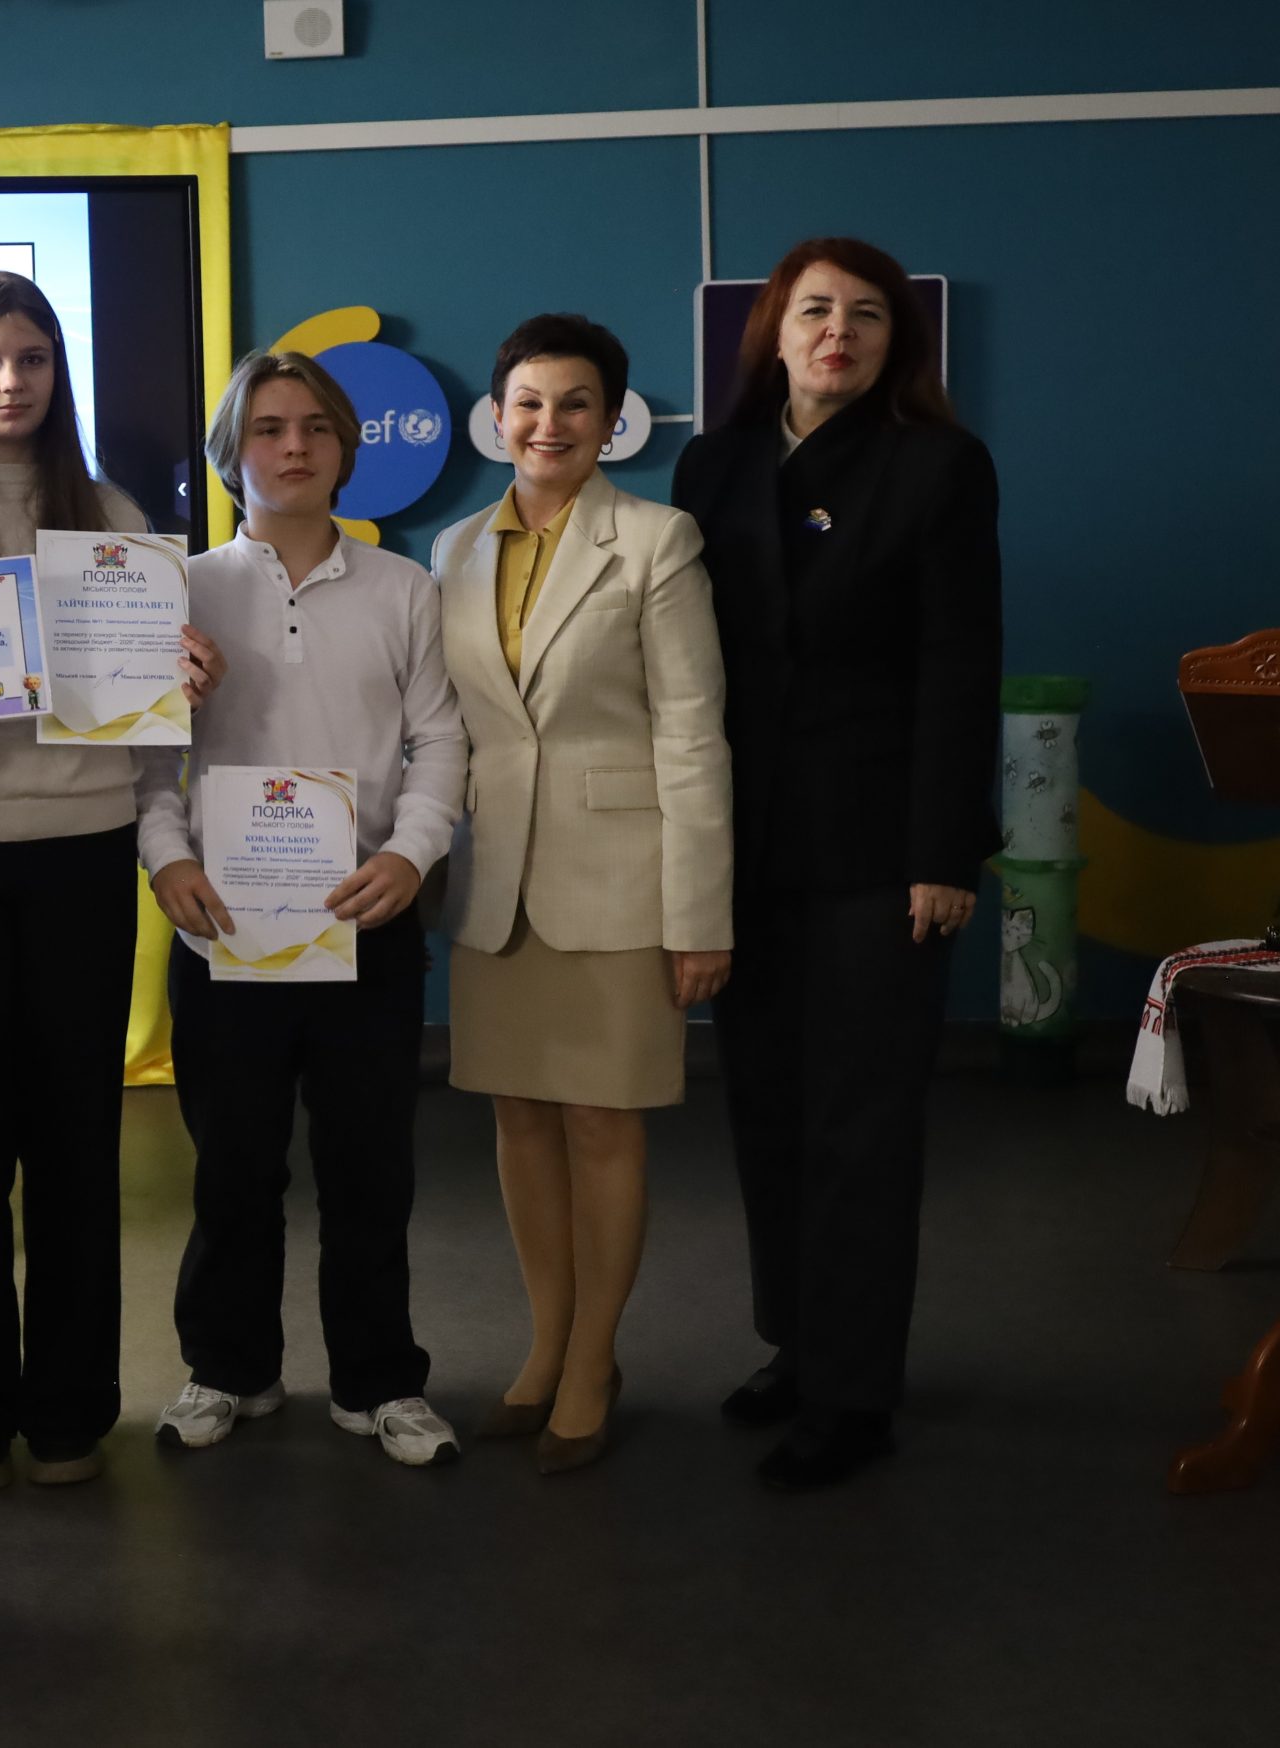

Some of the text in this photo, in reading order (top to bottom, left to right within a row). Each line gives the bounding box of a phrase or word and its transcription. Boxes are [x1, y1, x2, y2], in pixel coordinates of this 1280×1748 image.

[82, 570, 147, 585] ПОДЯКА
[57, 598, 174, 609] ЗАЙЧЕНКО ЄЛИЗАВЕТІ
[252, 805, 314, 820] ПОДЯКА
[245, 834, 320, 845] КОВАЛЬСЬКОМУ
